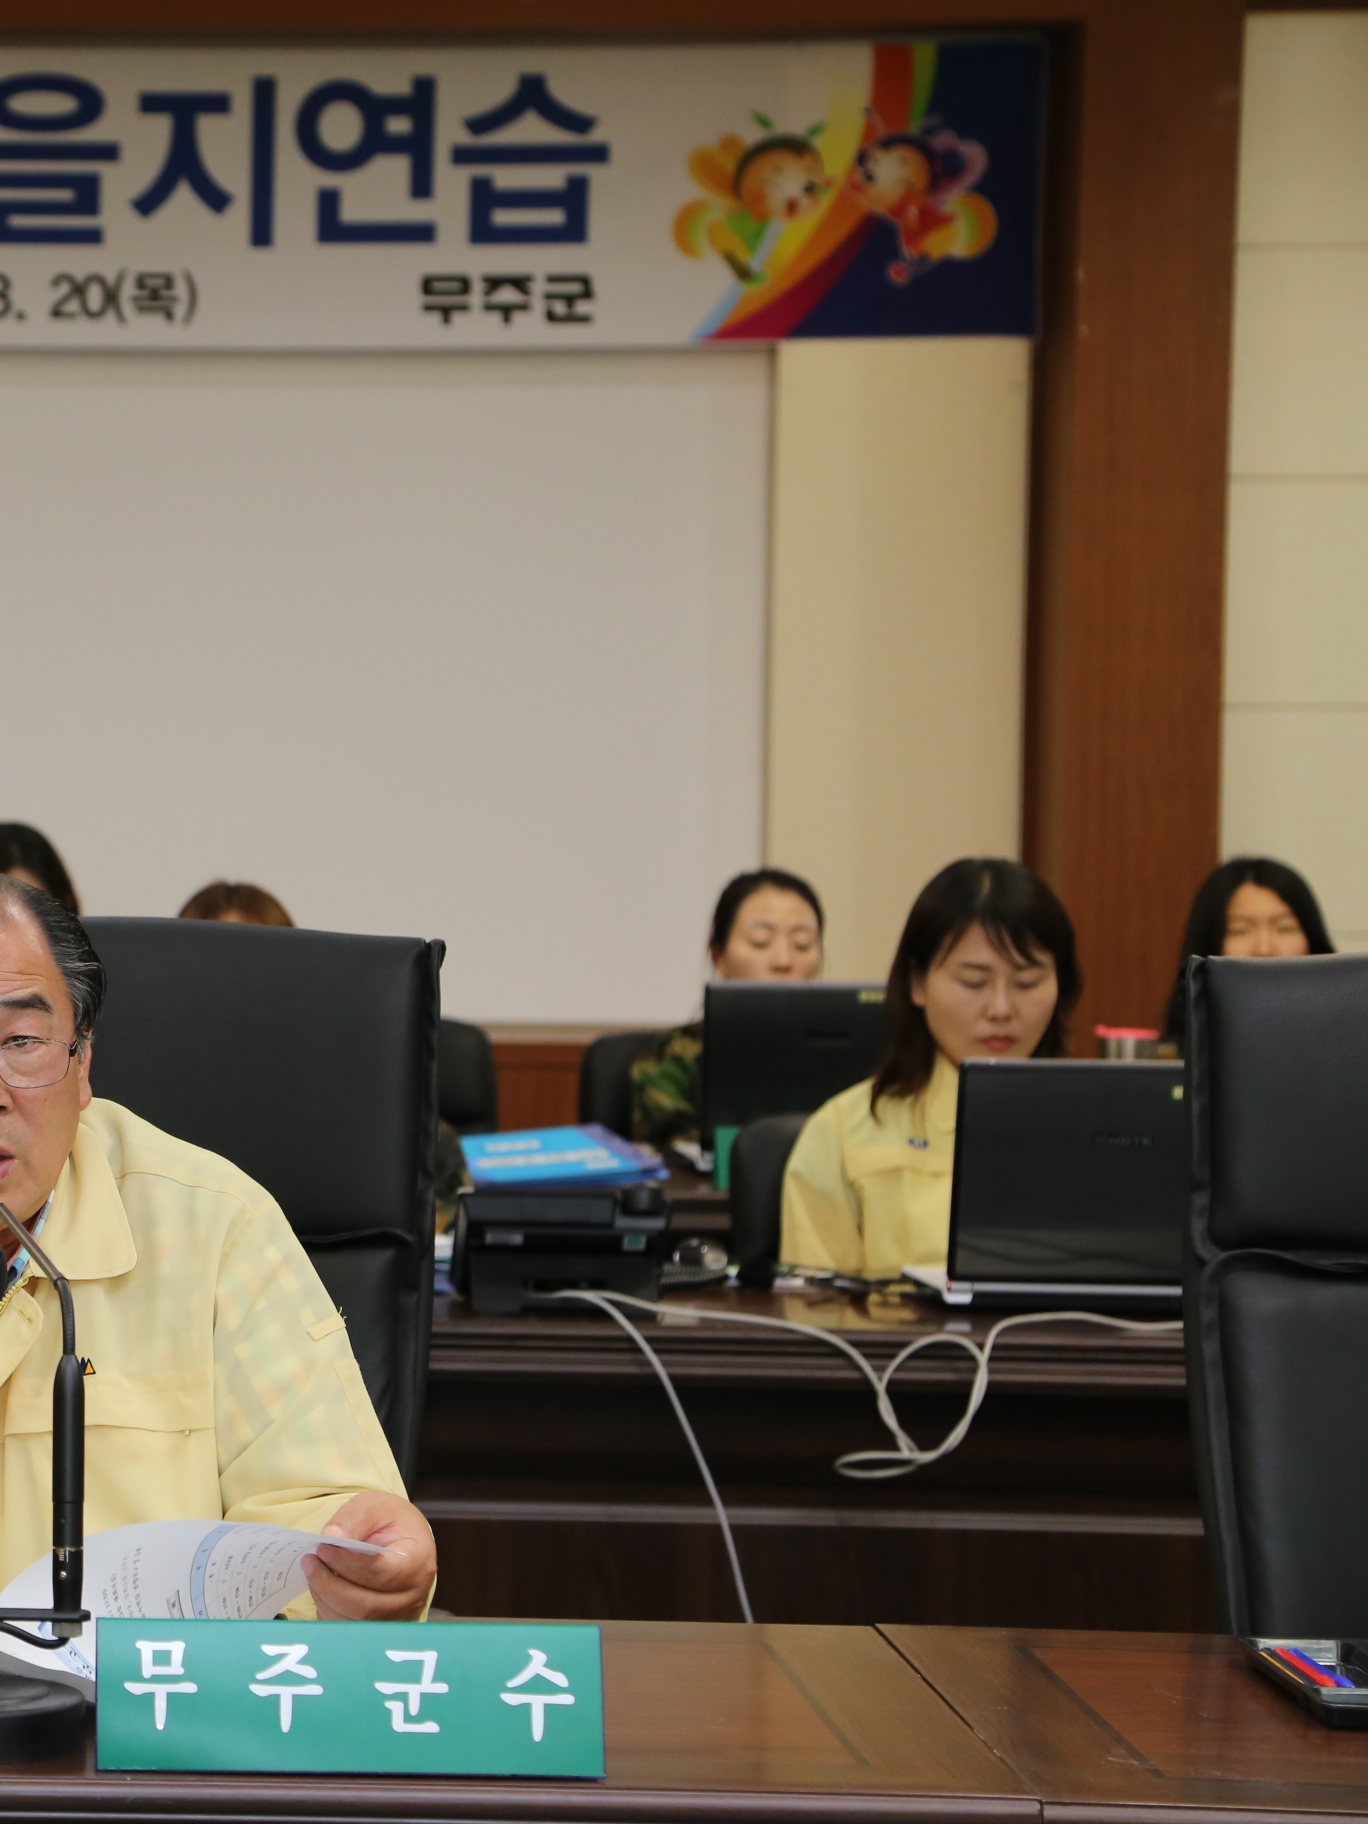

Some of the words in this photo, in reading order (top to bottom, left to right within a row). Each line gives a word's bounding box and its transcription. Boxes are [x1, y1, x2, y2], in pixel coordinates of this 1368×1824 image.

[48, 267, 199, 324] 20(목)
[418, 271, 597, 326] 무주군
[122, 1637, 577, 1743] 무주군수
